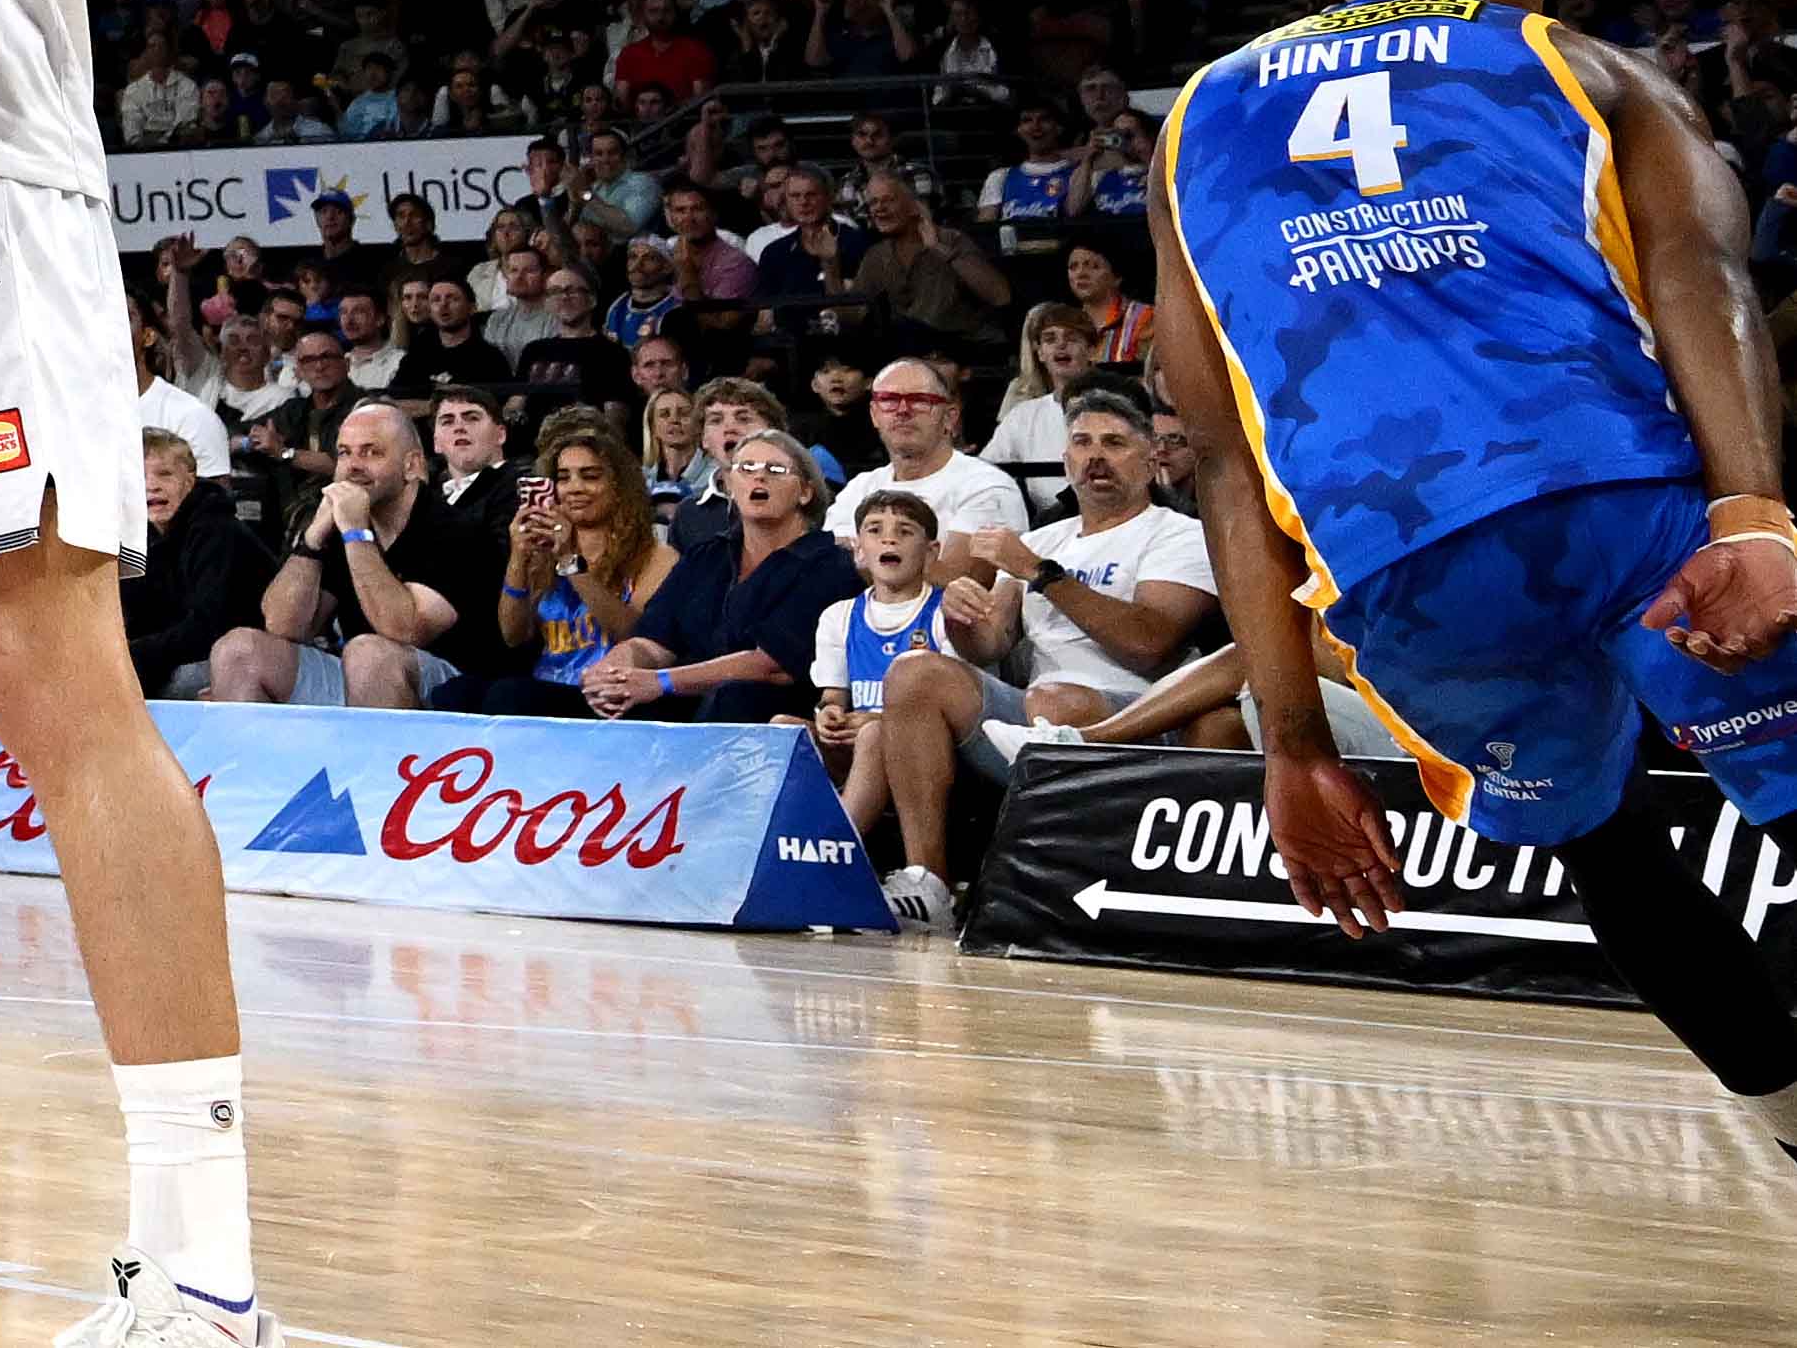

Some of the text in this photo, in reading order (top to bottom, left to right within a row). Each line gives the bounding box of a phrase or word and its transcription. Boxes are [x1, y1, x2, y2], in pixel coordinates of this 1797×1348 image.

[1259, 25, 1450, 87] HINTON
[1288, 71, 1407, 197] 4
[113, 175, 245, 223] UniSC
[1280, 195, 1467, 242] CONSTRUCTION
[1300, 232, 1486, 292] PATHWAYS
[1690, 700, 1797, 744] Tyrepowe
[379, 748, 688, 869] Coors
[1483, 781, 1542, 802] CENTRAL
[778, 836, 855, 865] HART
